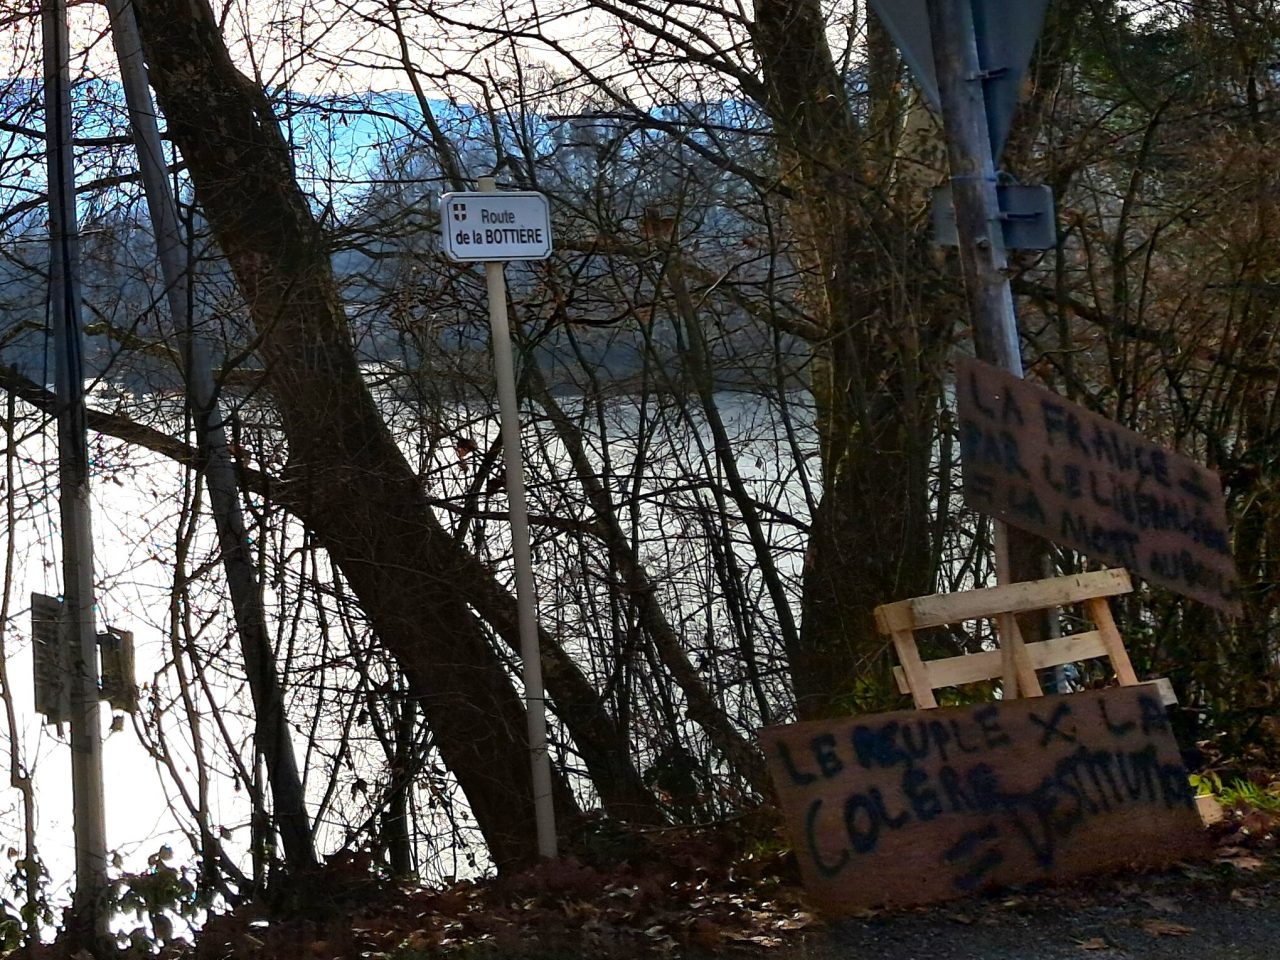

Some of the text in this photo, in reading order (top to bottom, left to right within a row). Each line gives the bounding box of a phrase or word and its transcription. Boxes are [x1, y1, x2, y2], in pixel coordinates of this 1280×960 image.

[481, 208, 516, 224] Route
[456, 230, 470, 245] de
[472, 230, 483, 244] la
[777, 734, 843, 786] LE
[1099, 694, 1170, 738] LA
